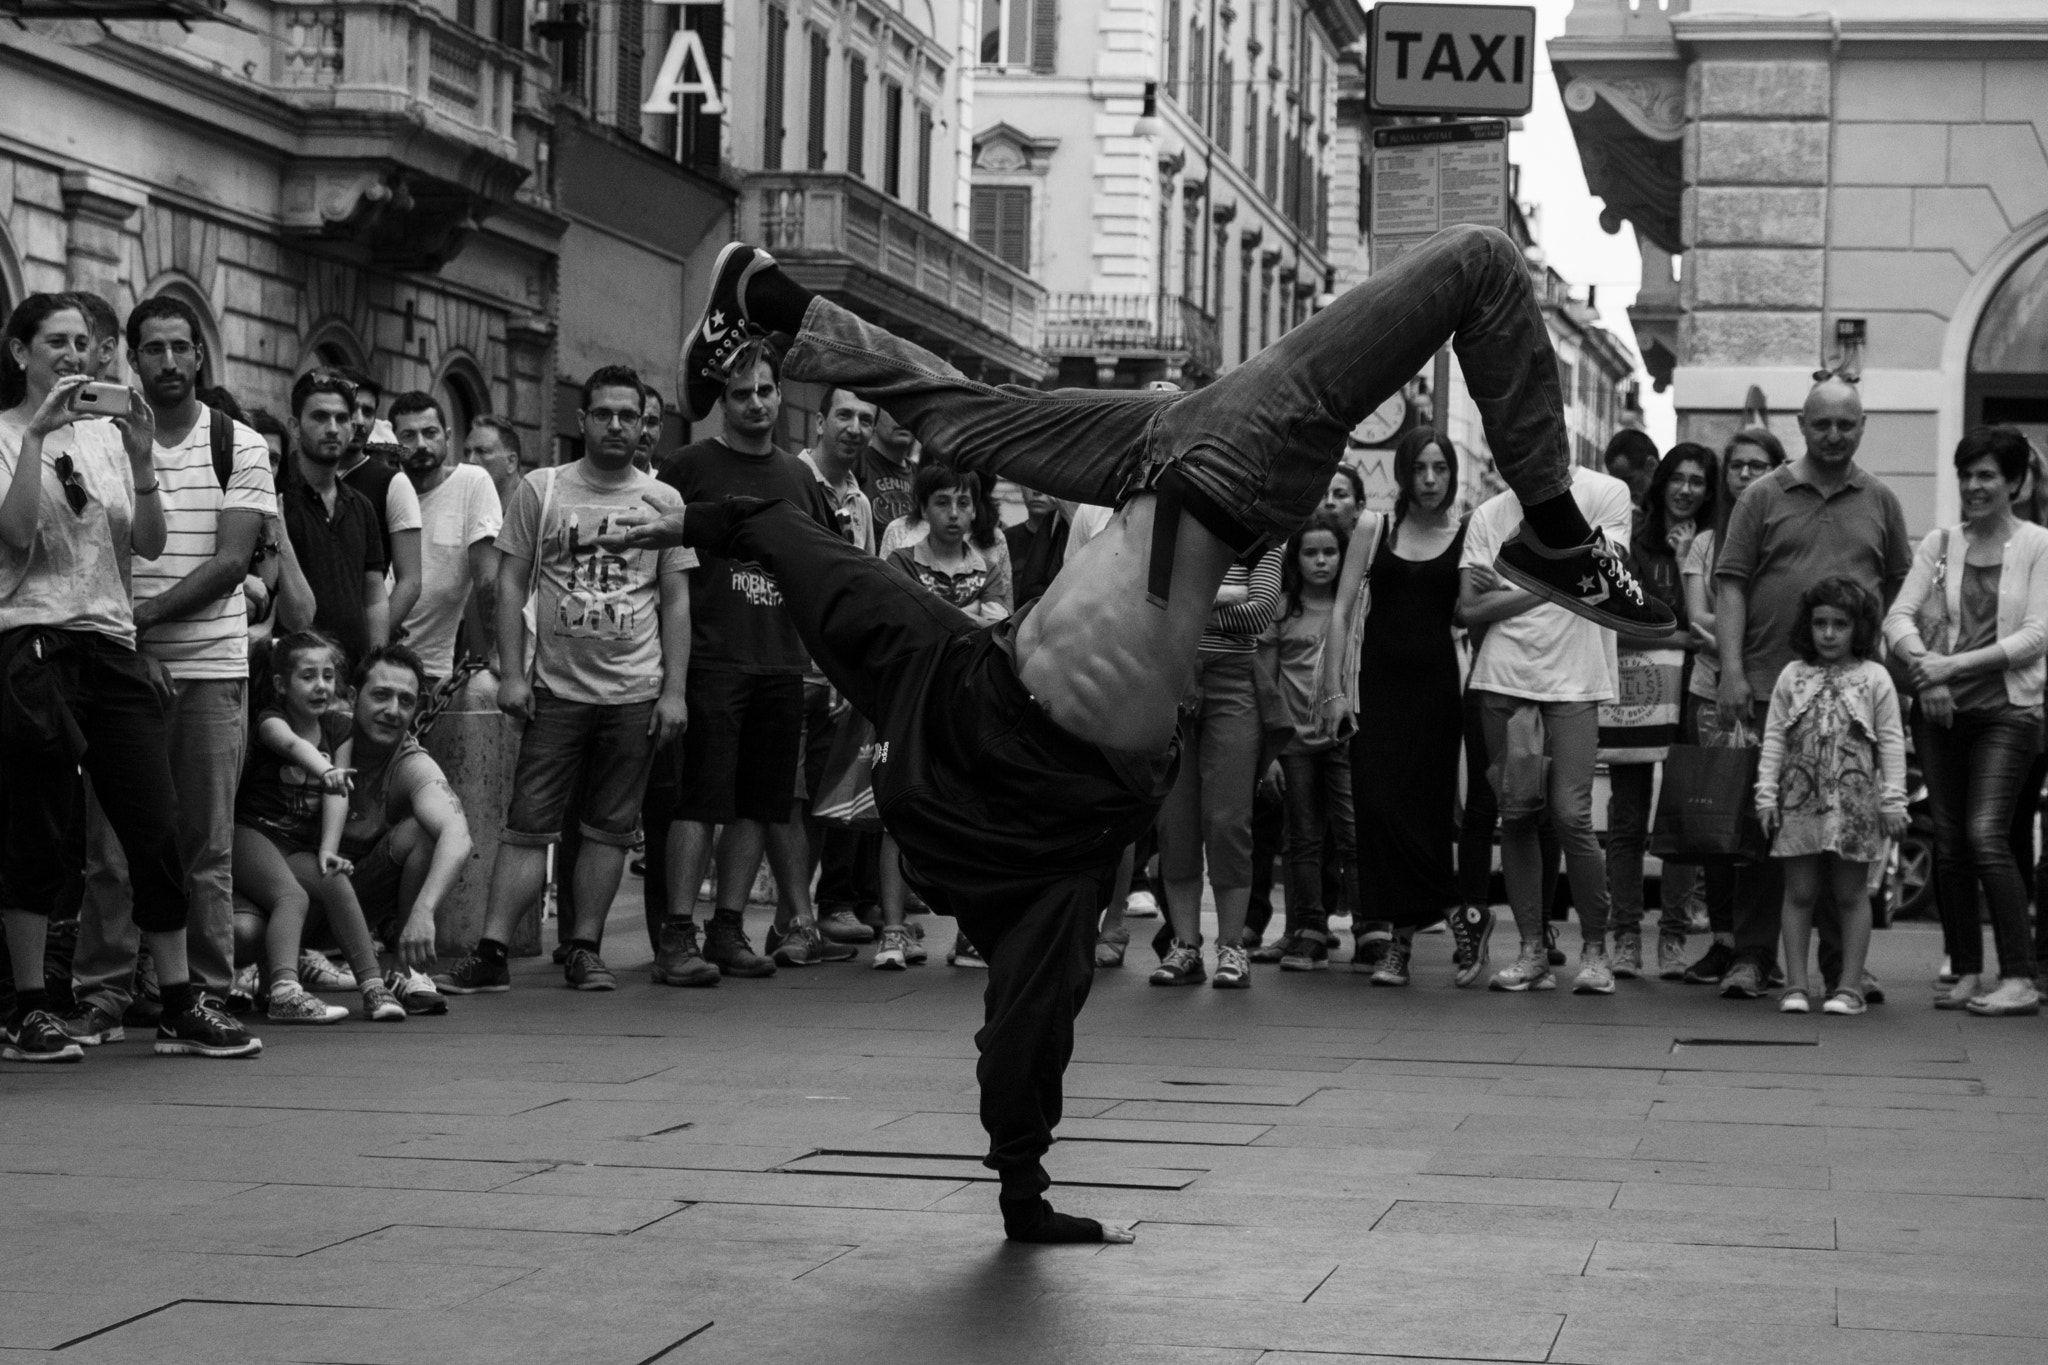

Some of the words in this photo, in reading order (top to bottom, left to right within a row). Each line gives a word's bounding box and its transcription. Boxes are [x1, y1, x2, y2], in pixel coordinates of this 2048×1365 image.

[641, 29, 726, 115] A
[1385, 31, 1526, 84] TAXI
[1619, 679, 1656, 695] ILLS
